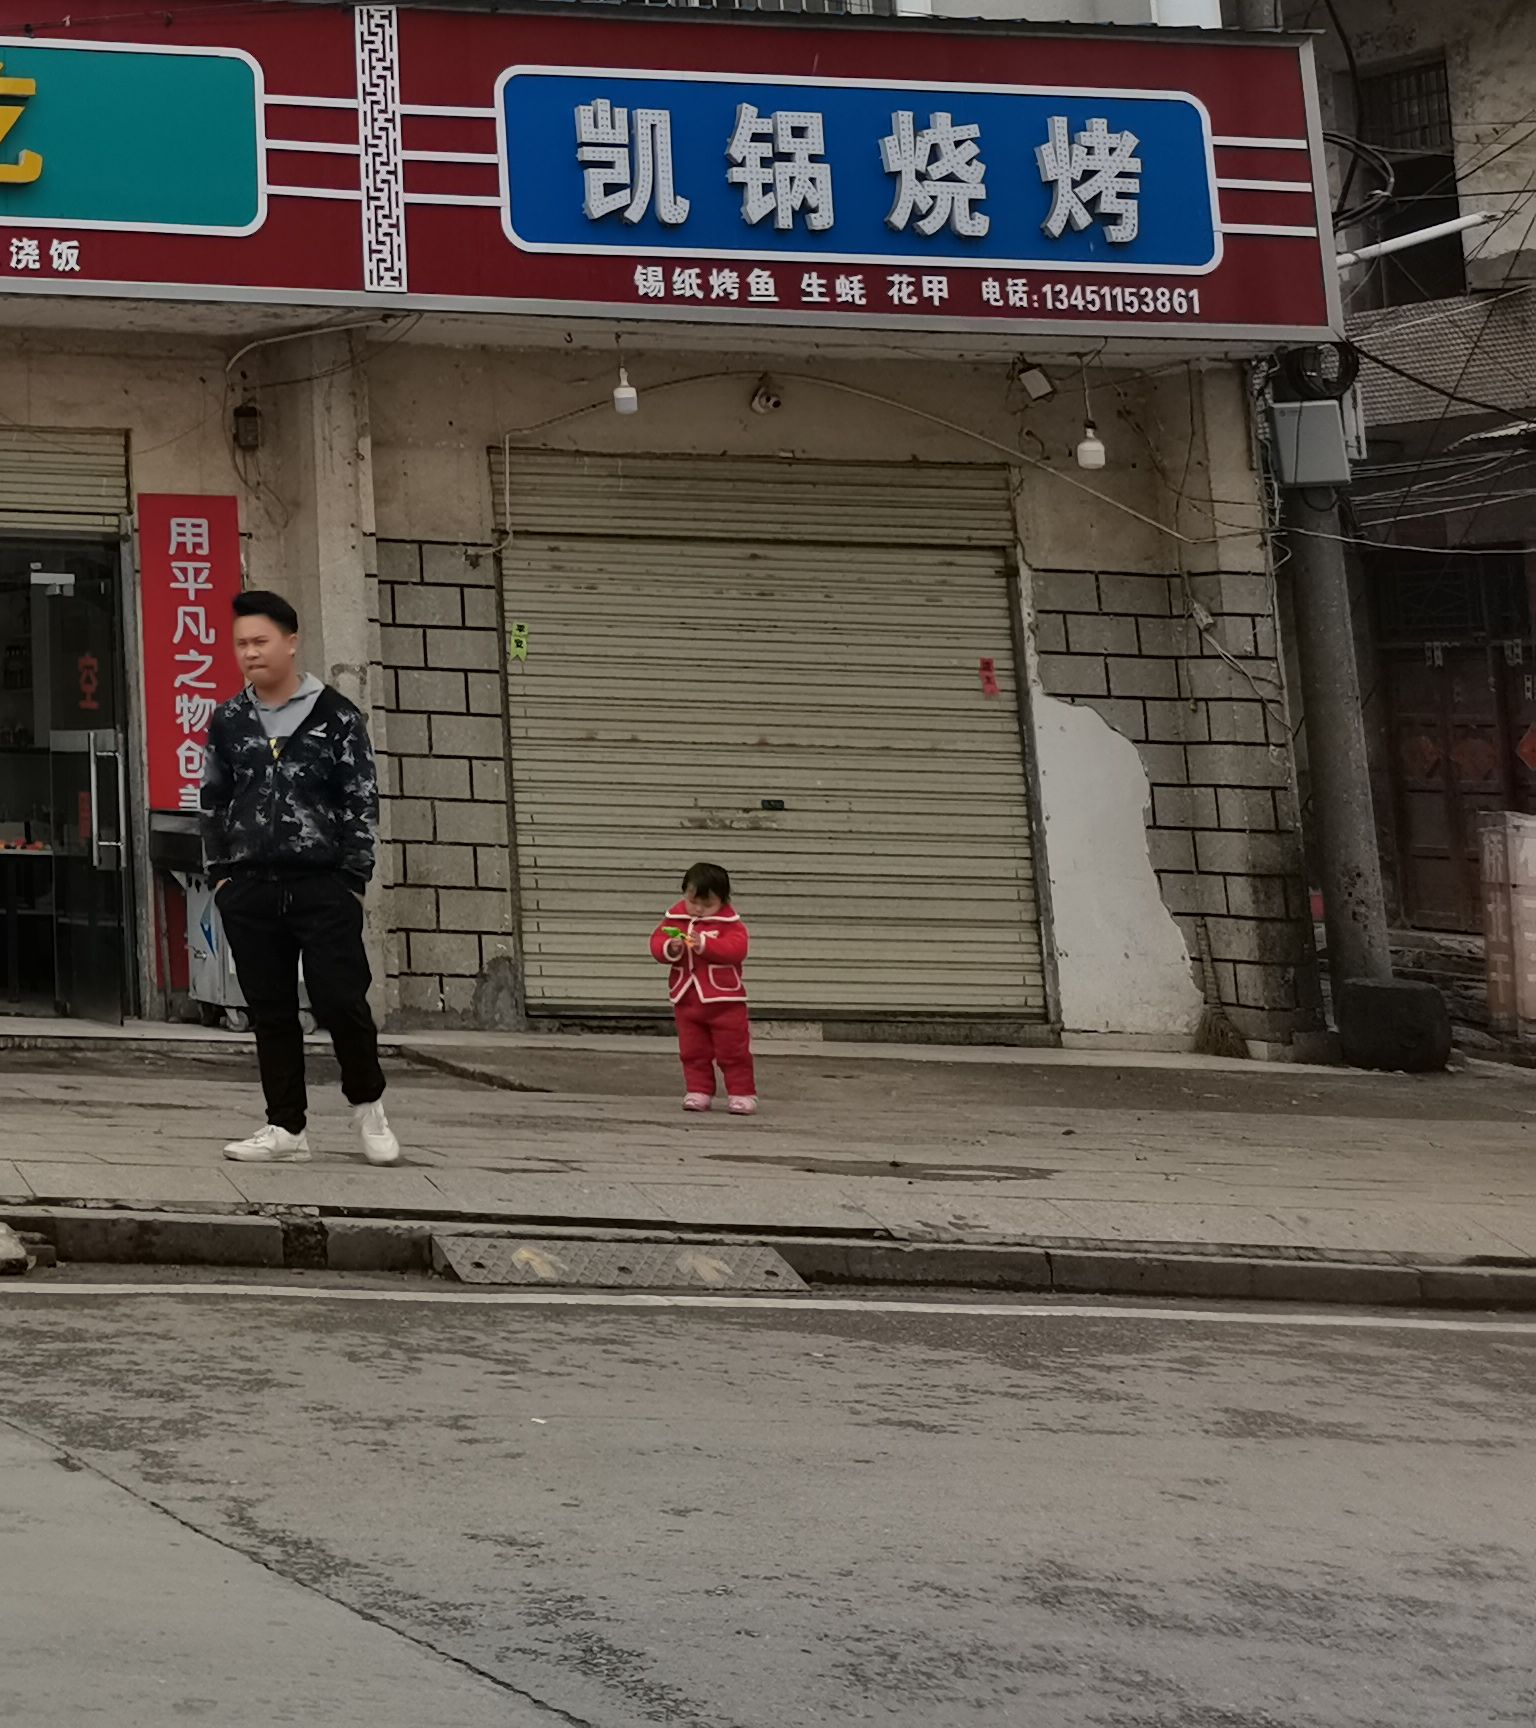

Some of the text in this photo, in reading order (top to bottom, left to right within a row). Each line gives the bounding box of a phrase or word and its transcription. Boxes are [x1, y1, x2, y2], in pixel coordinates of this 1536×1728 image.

[575, 97, 1143, 243] 凯锅烧烤
[632, 265, 780, 304] 锡纸烤鱼
[800, 271, 867, 306] 生蚝
[888, 273, 949, 306] 花甲
